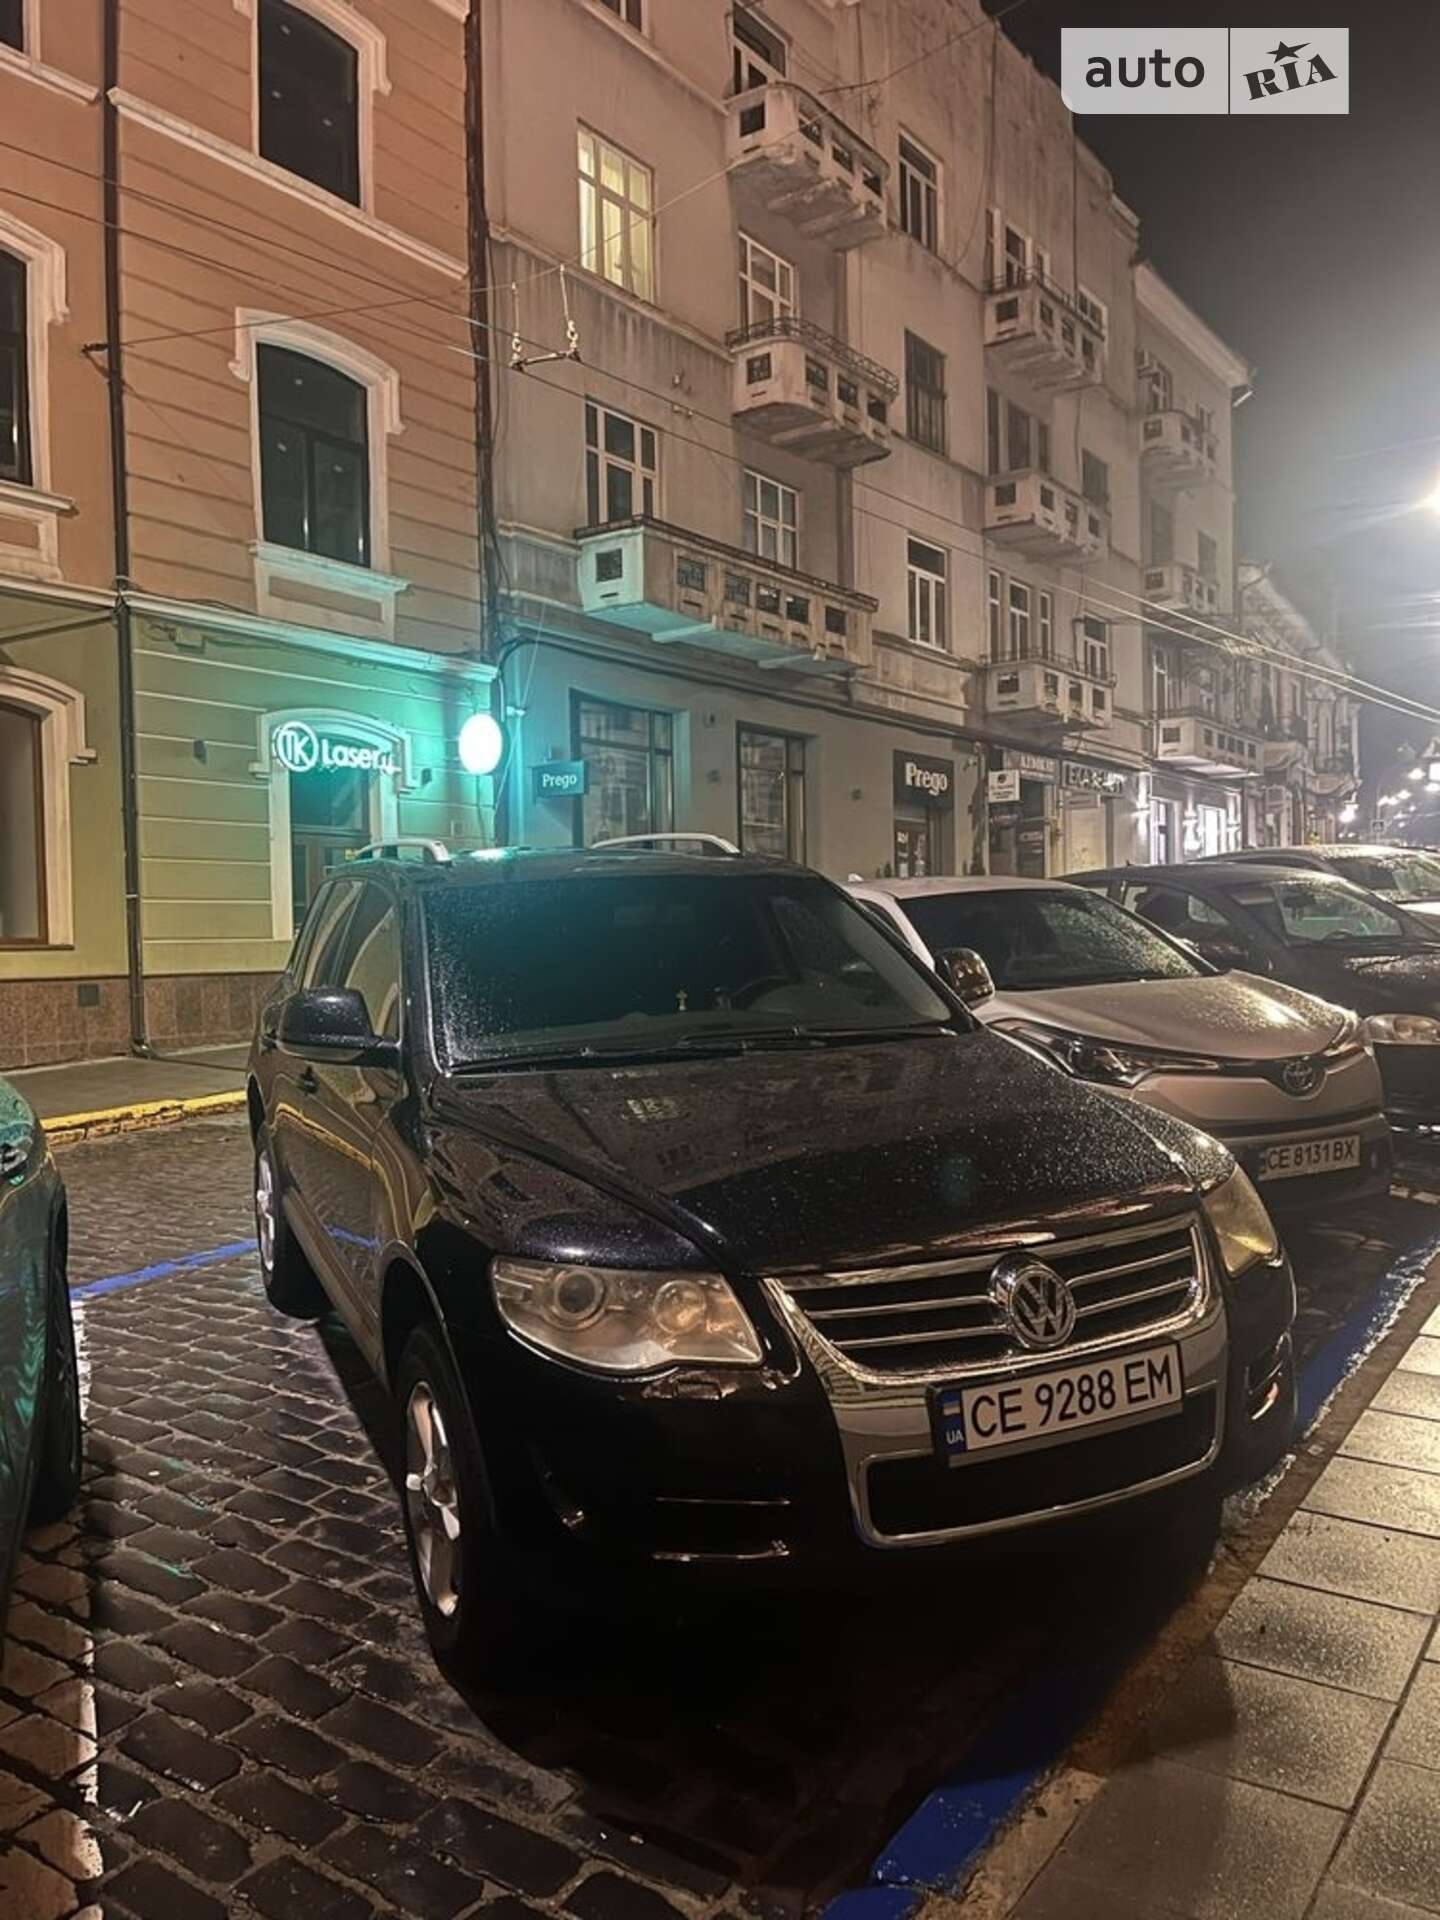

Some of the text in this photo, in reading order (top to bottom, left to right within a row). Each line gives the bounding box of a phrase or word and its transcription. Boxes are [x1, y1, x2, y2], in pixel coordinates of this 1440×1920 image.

[541, 773, 577, 790] Prego
[904, 762, 948, 796] Prego
[1267, 1140, 1355, 1169] CE 8131 BX
[971, 1354, 1174, 1438] CE 9288 EM
[945, 1427, 965, 1445] UA
